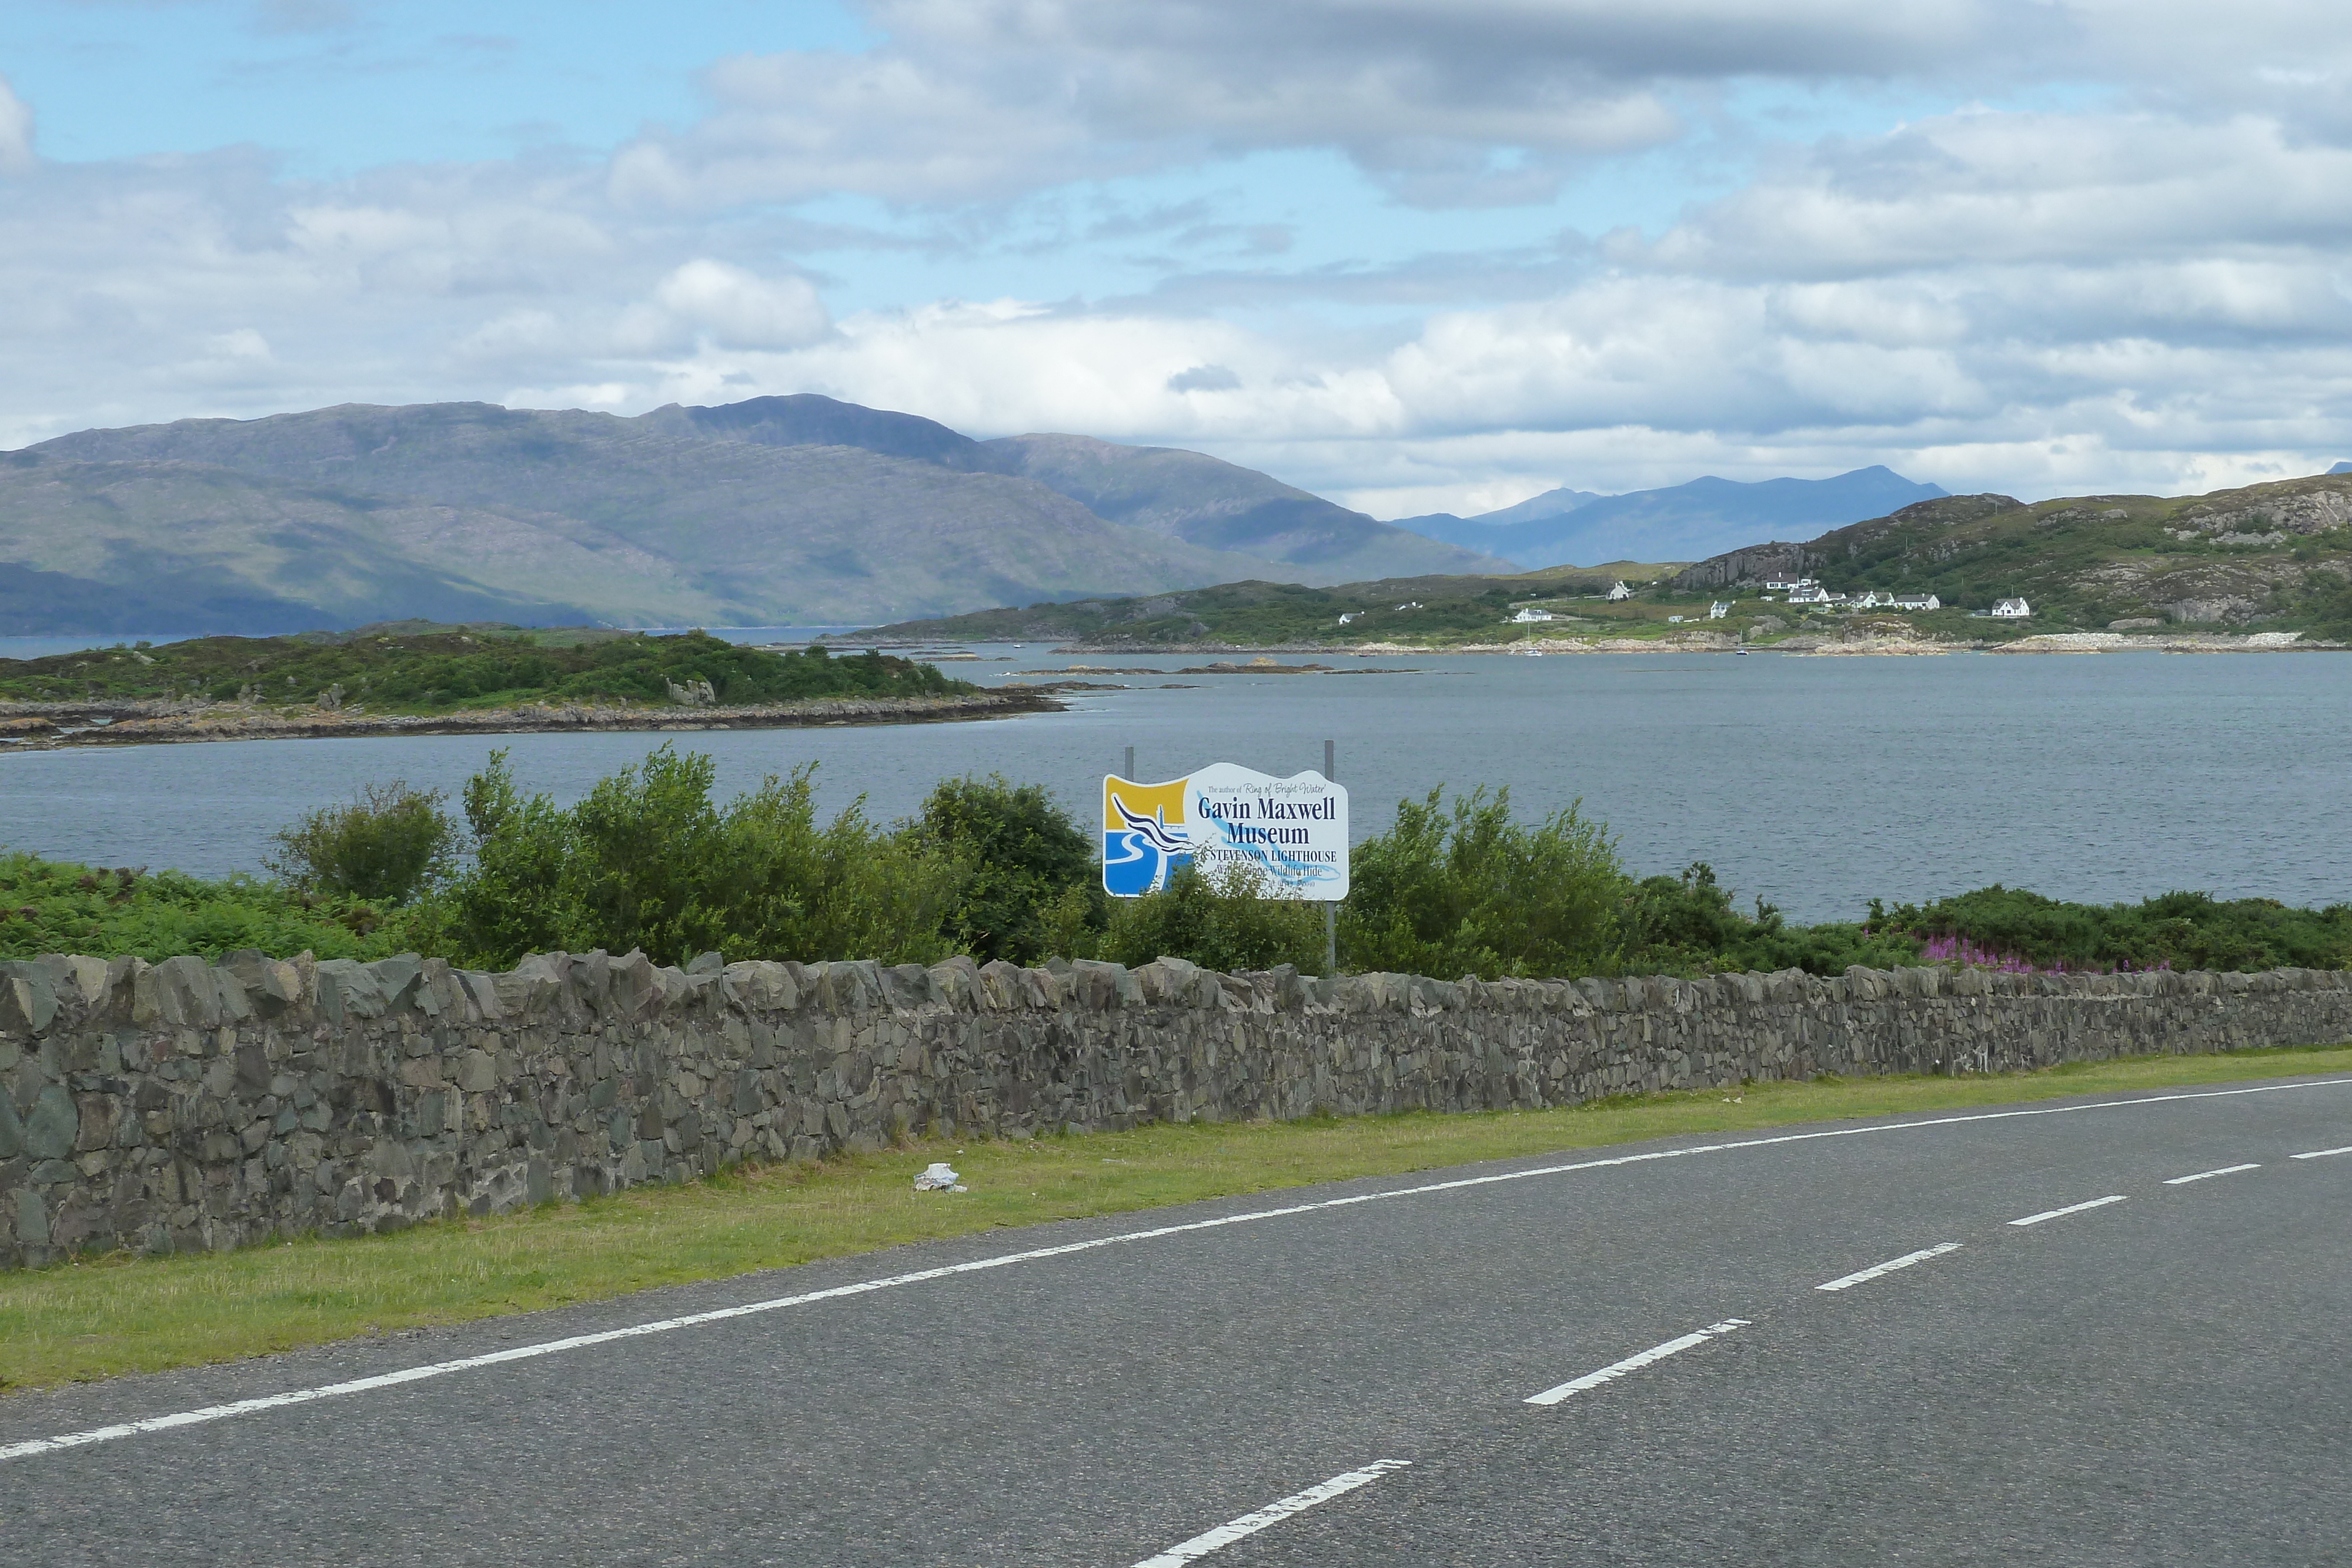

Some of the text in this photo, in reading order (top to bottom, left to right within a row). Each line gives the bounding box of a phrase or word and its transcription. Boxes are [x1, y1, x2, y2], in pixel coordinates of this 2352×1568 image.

[1265, 783, 1272, 798] of
[1274, 783, 1298, 798] Bright
[1198, 796, 1336, 820] Gavin Maxwell
[1227, 823, 1310, 844] Museum
[1210, 849, 1268, 861] STEVENSON
[1271, 850, 1337, 862] LIGHTHOUSE
[1303, 865, 1322, 877] Hide
